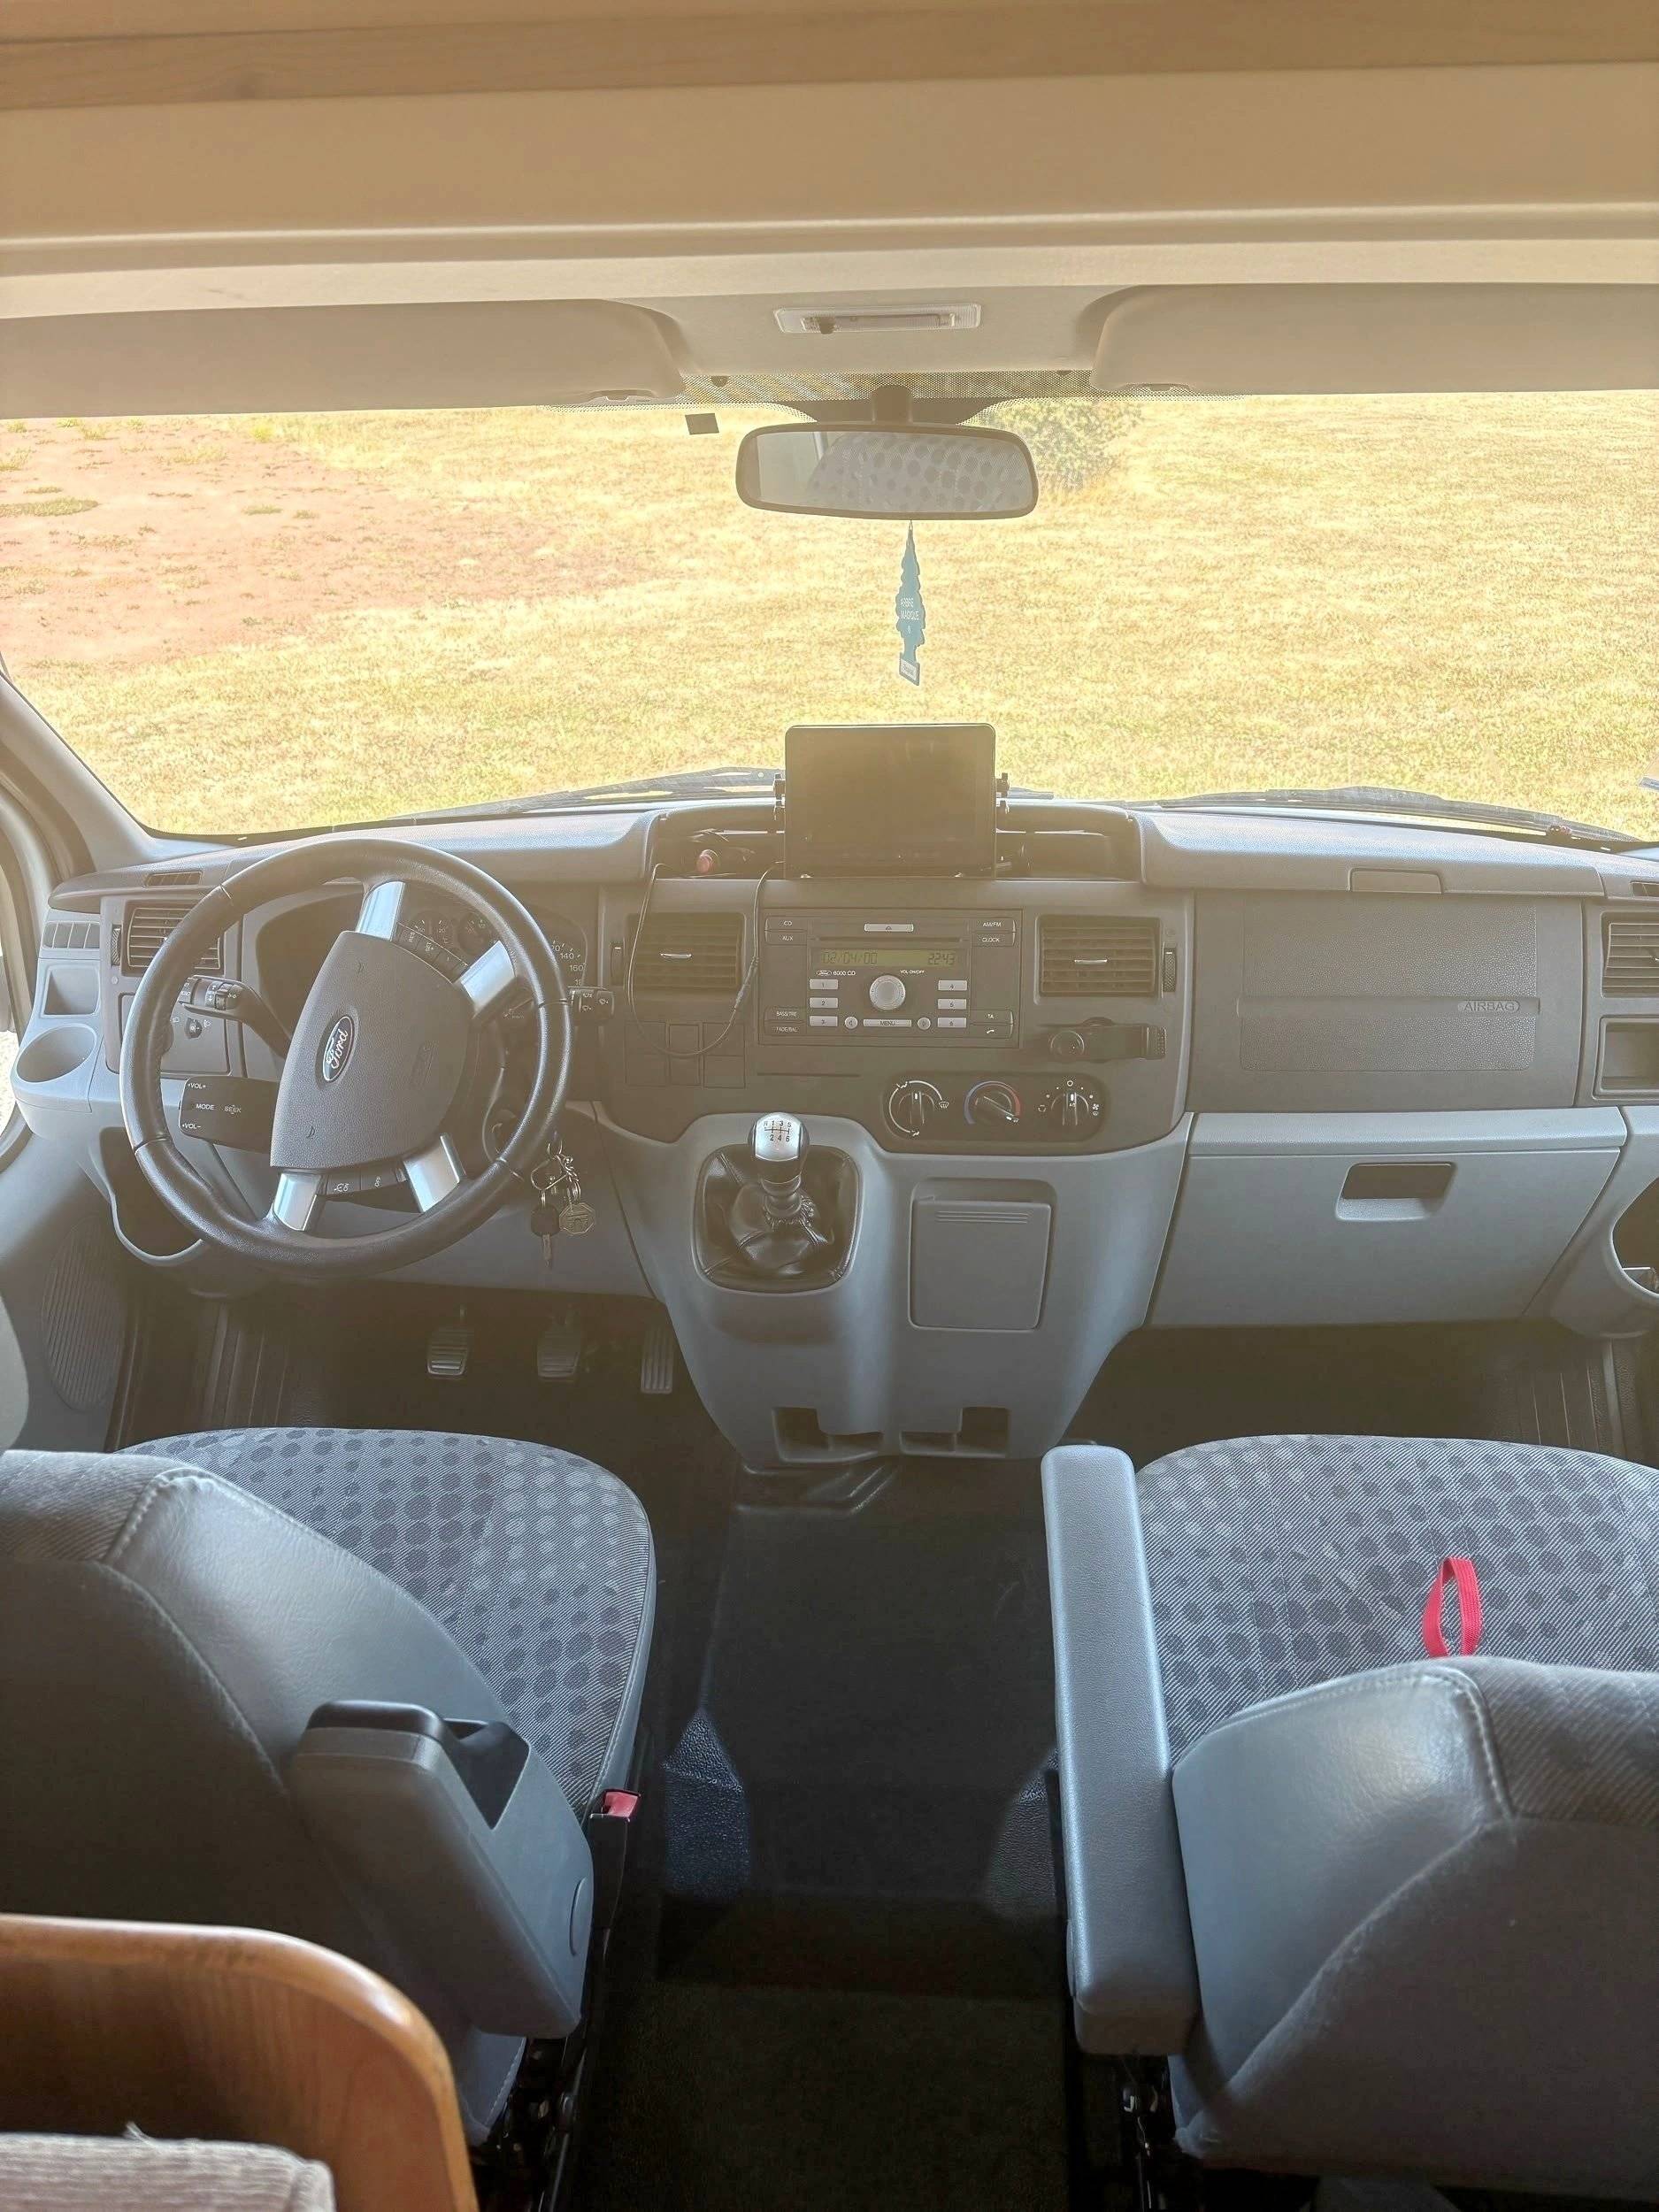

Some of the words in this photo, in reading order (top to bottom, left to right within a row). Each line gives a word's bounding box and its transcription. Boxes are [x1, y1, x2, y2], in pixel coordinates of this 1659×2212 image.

[569, 964, 585, 972] 160
[1463, 1001, 1516, 1012] AIRBAG
[326, 1028, 349, 1070] Ford
